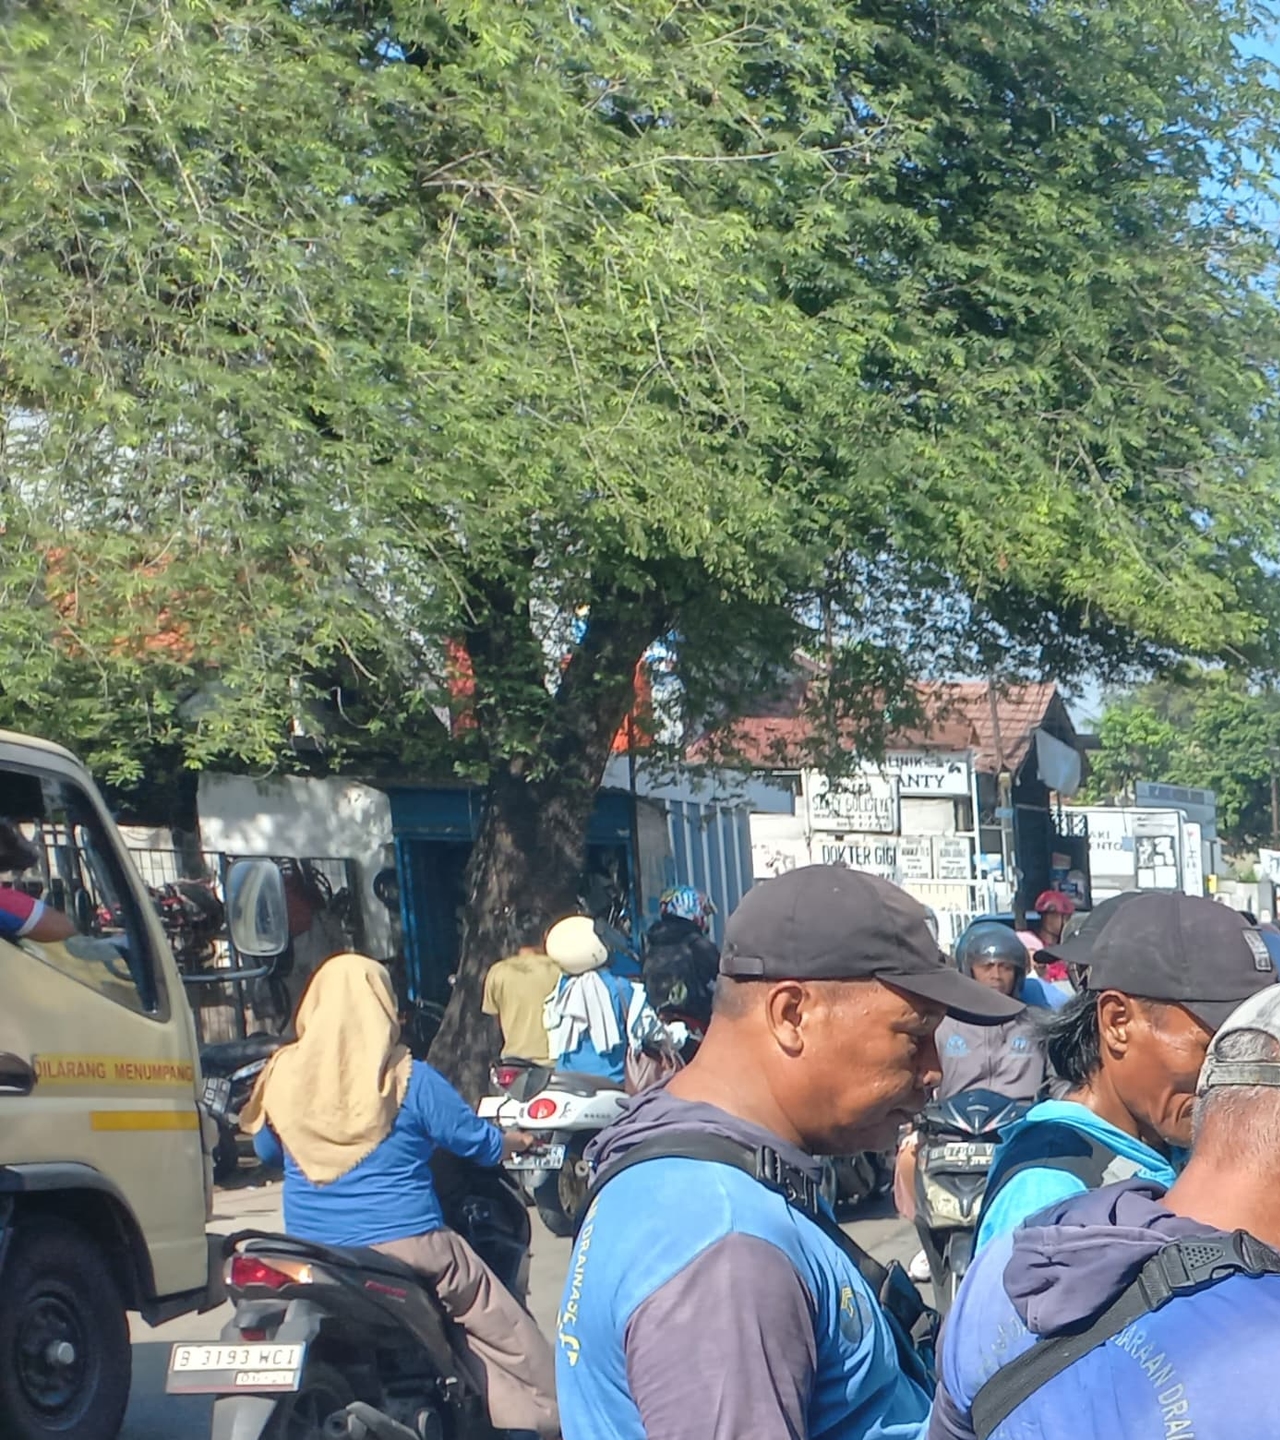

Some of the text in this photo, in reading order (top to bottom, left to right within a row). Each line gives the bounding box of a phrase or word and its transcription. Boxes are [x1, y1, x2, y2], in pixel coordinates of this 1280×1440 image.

[886, 755, 923, 768] LINIK
[898, 774, 945, 789] ANTY
[821, 844, 871, 866] DOKTER
[874, 845, 897, 867] GIGI
[35, 1061, 193, 1082] DILARANG MENUMPANG
[179, 1348, 296, 1367] B 3193 WCI
